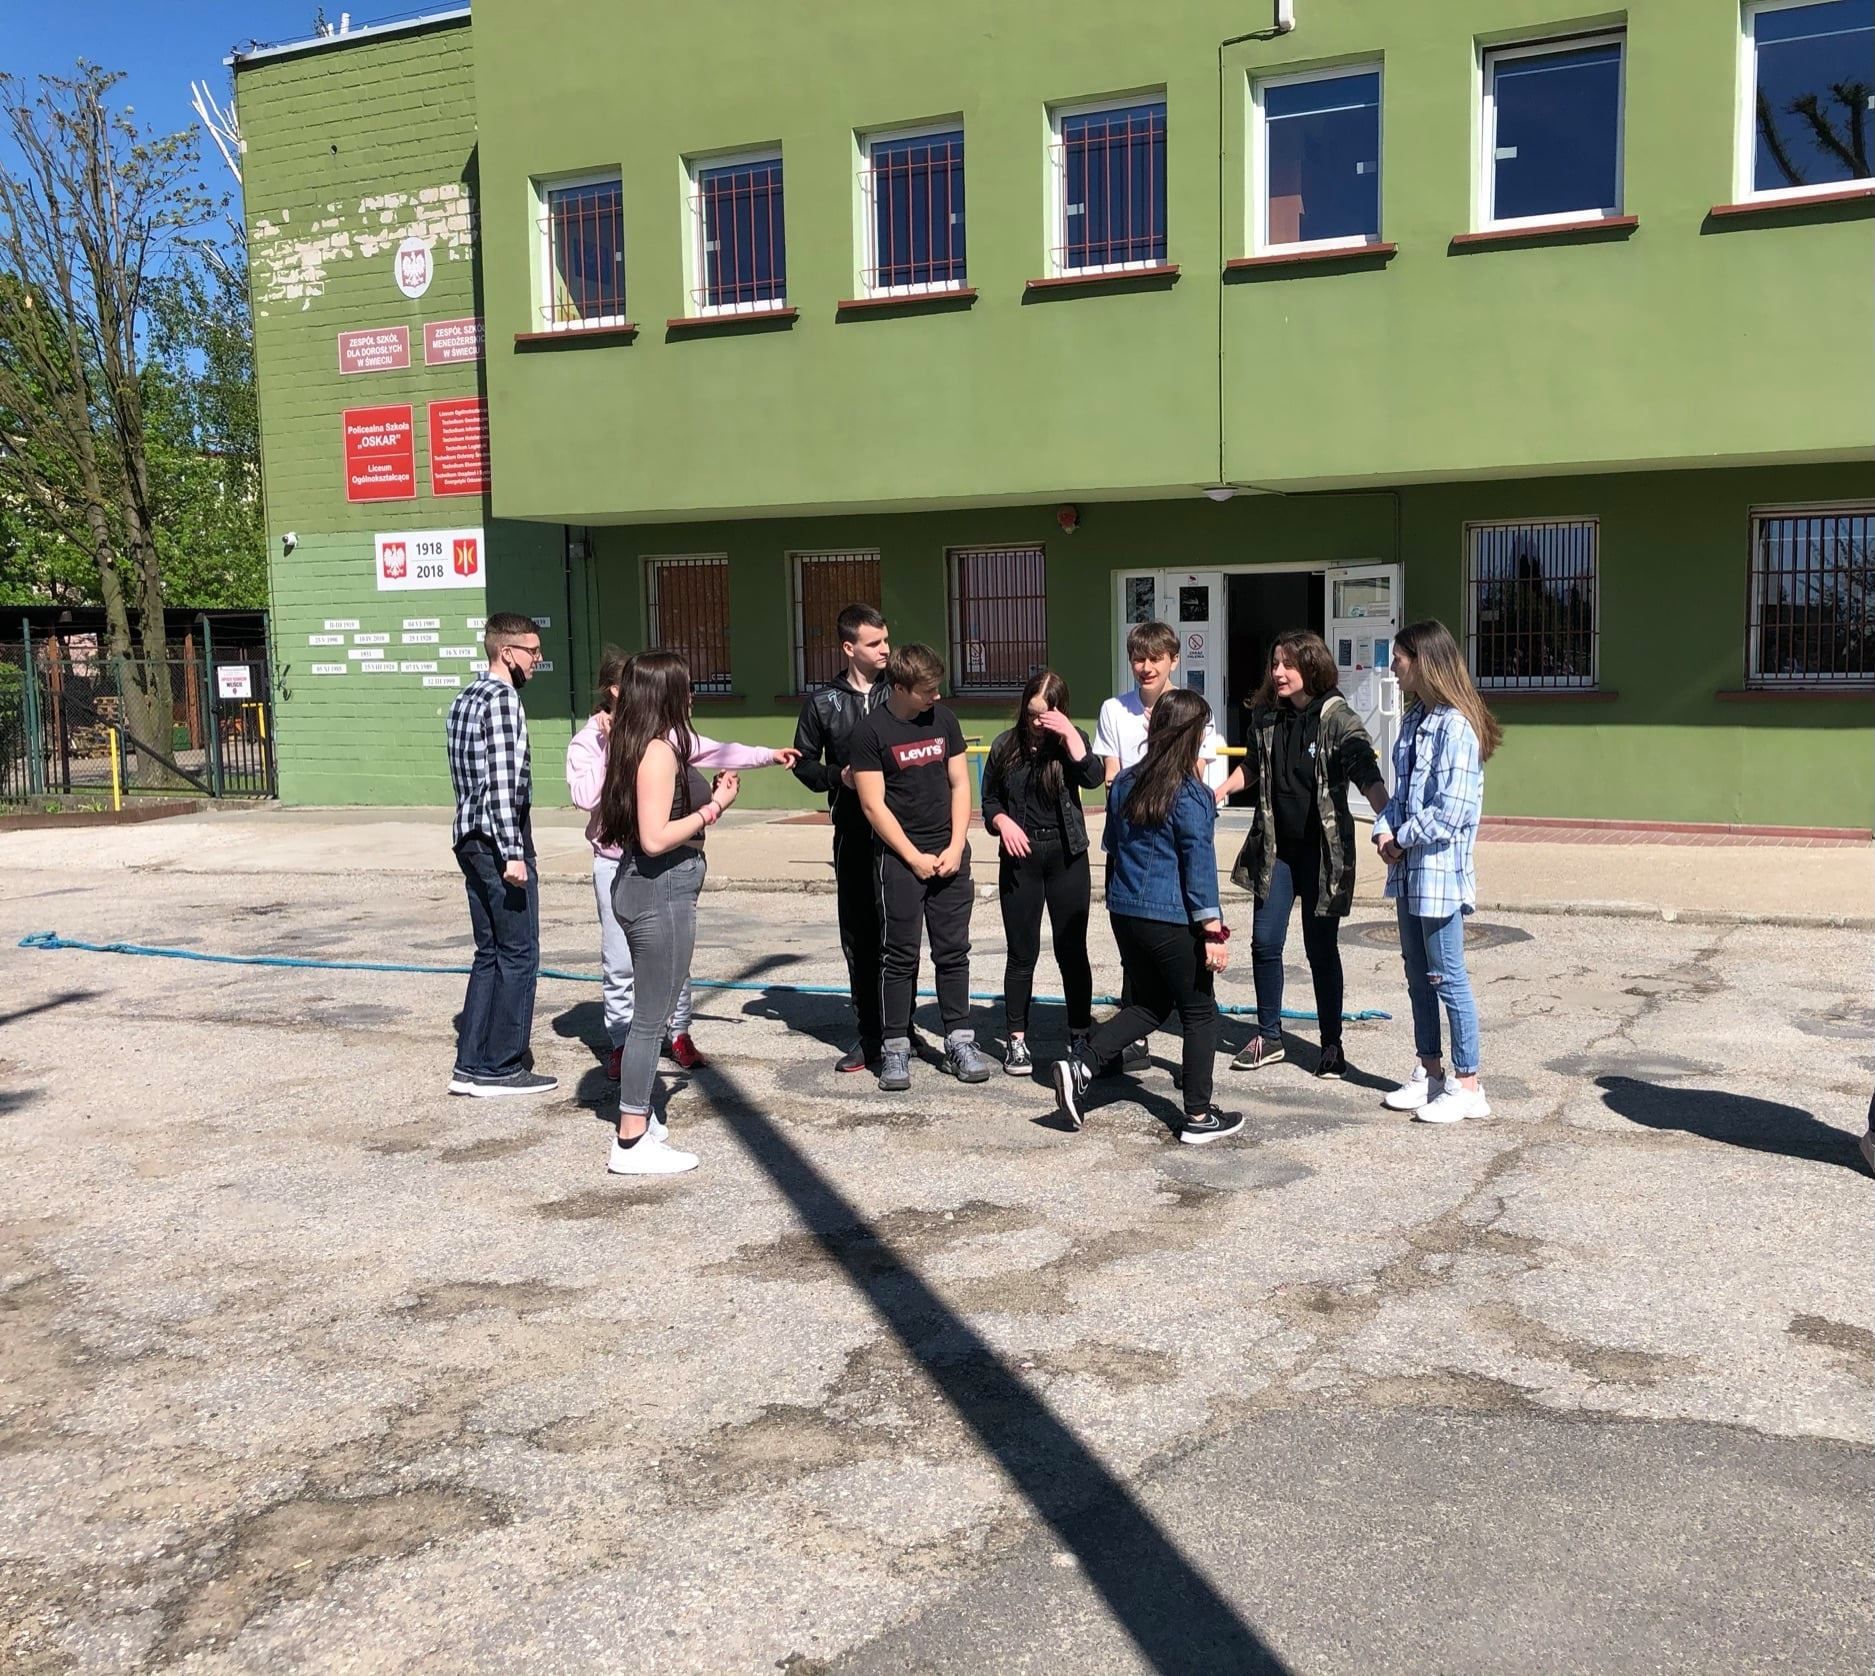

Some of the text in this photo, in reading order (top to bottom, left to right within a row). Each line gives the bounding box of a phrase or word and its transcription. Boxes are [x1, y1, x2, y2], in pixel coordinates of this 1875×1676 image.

[435, 326, 462, 338] ZESPÓŁ
[349, 332, 399, 347] ZESPÓŁ SZKÓŁ
[347, 344, 402, 358] DLA DOROSŁYCH
[443, 346, 480, 358] W ŚWIECIU
[357, 354, 392, 367] W ŚWIECIU
[348, 422, 410, 434] Policealna Szkoła
[368, 464, 392, 472] Liceum
[352, 474, 410, 485] Ogólnokształcące
[416, 542, 442, 556] 1918
[416, 564, 444, 578] 2018
